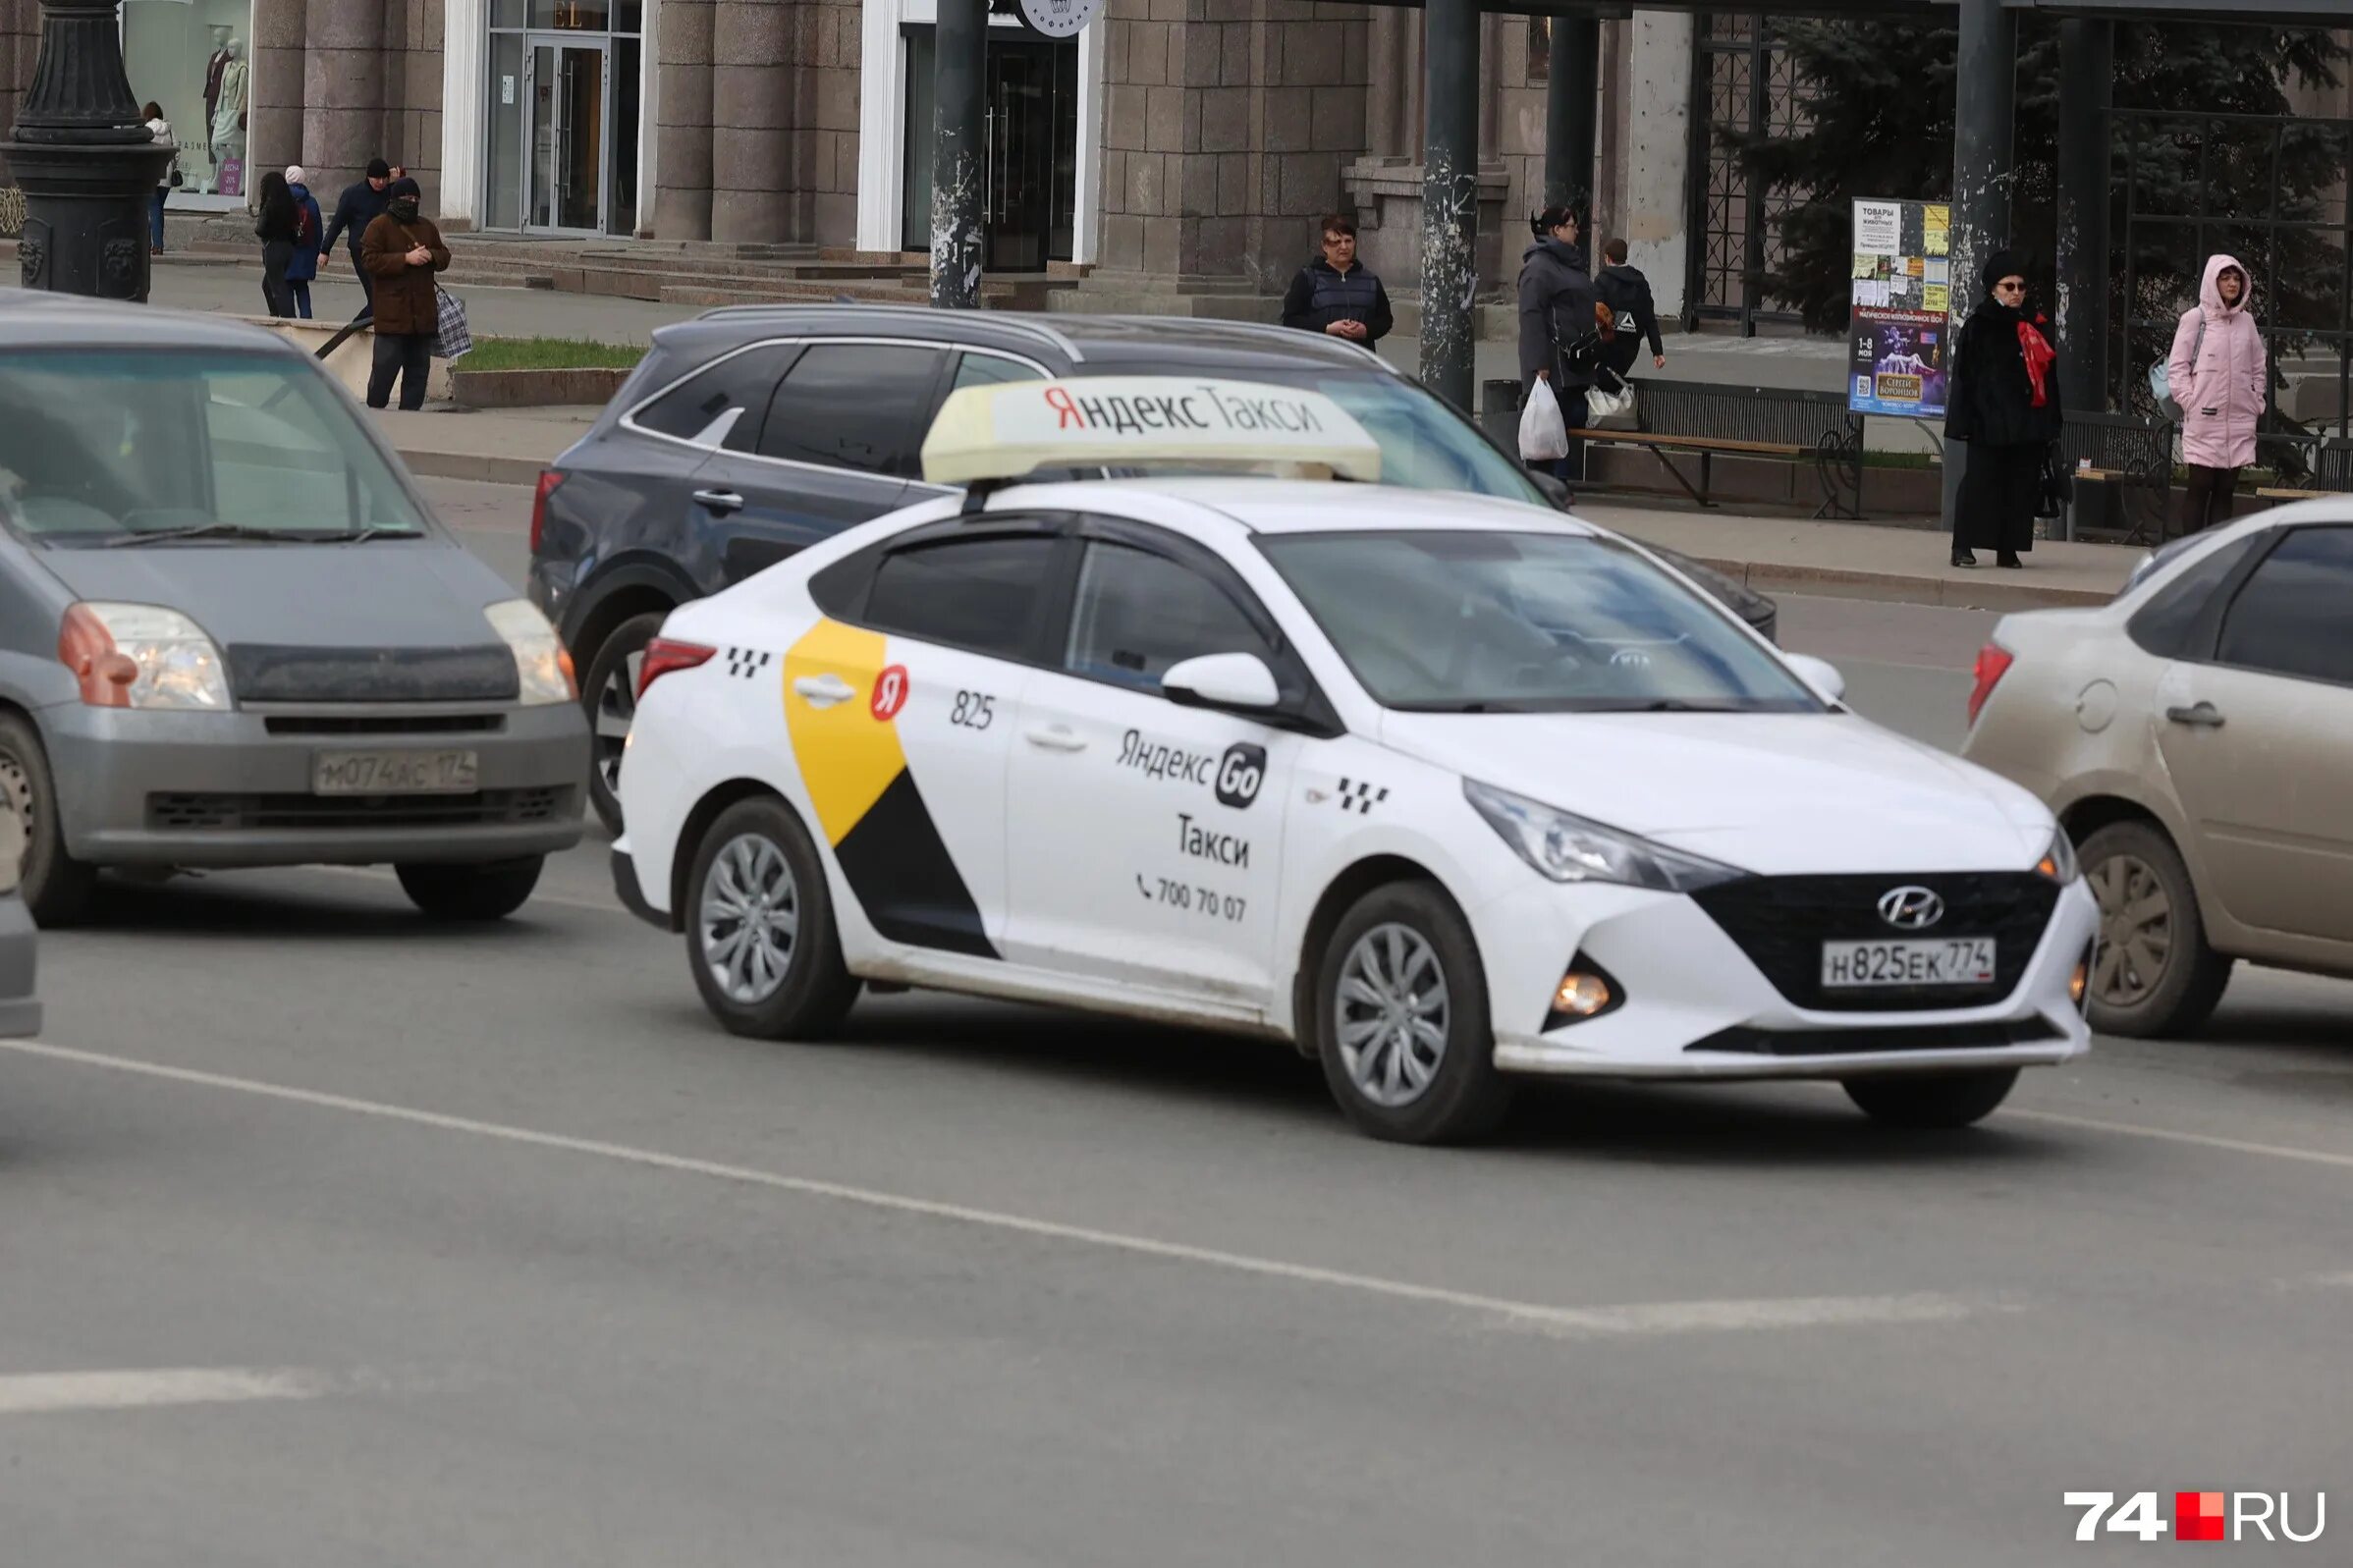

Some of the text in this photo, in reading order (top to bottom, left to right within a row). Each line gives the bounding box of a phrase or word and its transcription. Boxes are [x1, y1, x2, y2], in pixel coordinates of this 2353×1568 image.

[1862, 207, 1894, 217] ТОВАРЫ
[1858, 337, 1873, 349] 1-8
[1043, 386, 1324, 435] Яндекс Такси
[950, 689, 997, 730] 825
[1117, 729, 1262, 799] Яндекс Go
[1177, 812, 1250, 869] Такси
[1157, 878, 1247, 923] 700 70 07
